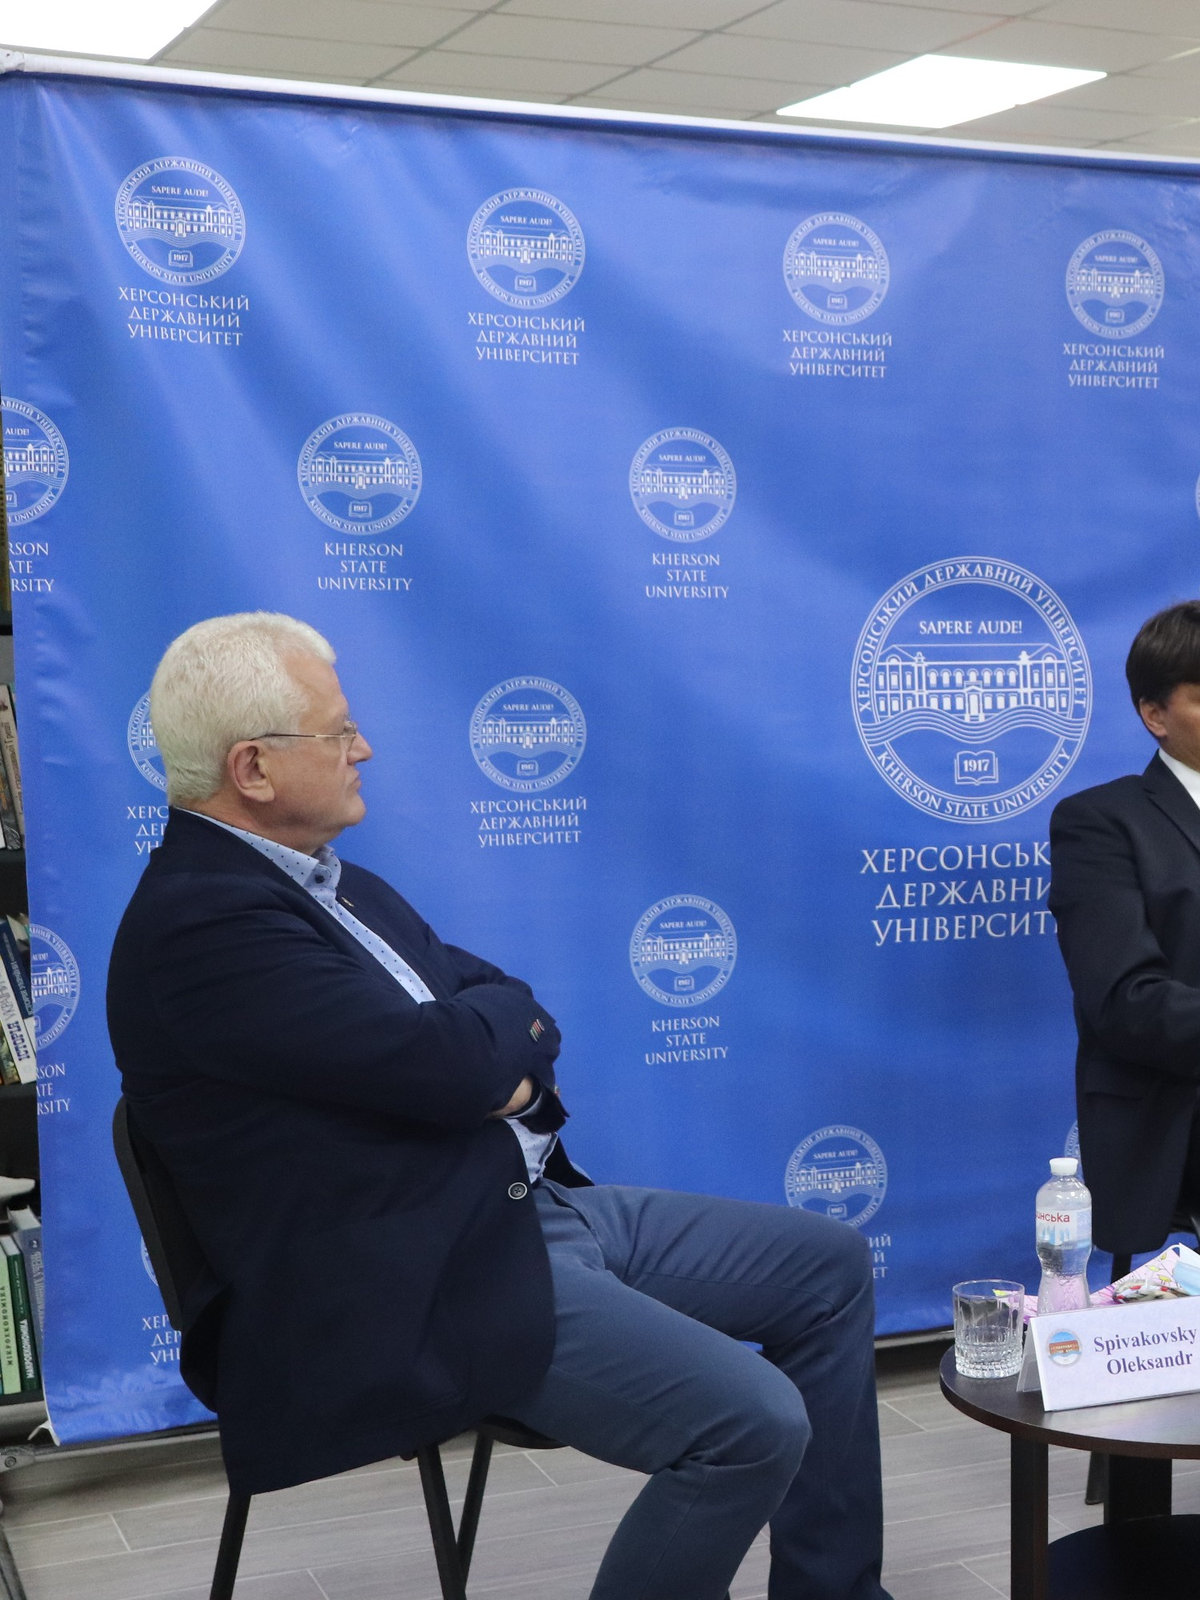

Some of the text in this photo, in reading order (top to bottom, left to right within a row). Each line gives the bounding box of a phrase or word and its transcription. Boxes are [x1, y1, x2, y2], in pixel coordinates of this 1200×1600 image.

[119, 287, 249, 310] ХЕРСОНСЬКИЙ
[127, 306, 240, 327] ДЕРЖАВНИЙ
[468, 312, 585, 332] ХЕРСОНСЬКИЙ
[128, 324, 242, 346] УНІВЕРСИТЕТ
[477, 330, 577, 348] ДЕРЖАВНИЙ
[782, 330, 893, 346] ХЕРСОНСЬКИЙ
[475, 347, 579, 365] УНІВЕРСИТЕТ
[791, 347, 885, 362] ДЕРЖАВНИЙ
[1063, 343, 1164, 358] ХЕРСОНСЬКИЙ
[789, 362, 886, 378] УНІВЕРСИТЕТ
[1070, 360, 1157, 373] ДЕРЖАВНИЙ
[1069, 374, 1159, 388] УНІВЕРСИТЕТ
[324, 543, 402, 557] KHERSON
[340, 560, 387, 574] STATE
[652, 553, 720, 566] KHERSON
[318, 577, 412, 590] UNIVERSITY
[666, 570, 707, 582] STATE
[645, 586, 729, 598] UNIVERSITY
[919, 620, 1023, 635] SAPERE AUDE!
[857, 563, 1087, 712] ХЕРСОНСЬКИЙ ДЕРЖАВНИЙ УНІВЕРСИТЕТ
[963, 759, 990, 772] 1917
[877, 747, 1071, 817] KHERSON STATE UNIVERSITY
[471, 797, 587, 814] ХЕРСОНСЬКИЙ
[479, 814, 578, 830] ДЕРЖАВНИЙ
[478, 831, 581, 847] УНІВЕРСИТЕТ
[860, 841, 1051, 874] ХЕРСОНСЬК
[871, 911, 1057, 946] УНІВЕРСИТ
[651, 1016, 720, 1032] KHERSON
[7, 1021, 30, 1061] ІСТОРІЯ
[666, 1032, 707, 1048] STATE
[645, 1046, 729, 1065] UNIVERSITY
[1094, 1326, 1198, 1355] Spivakovsky
[1107, 1350, 1194, 1376] Oleksandr
